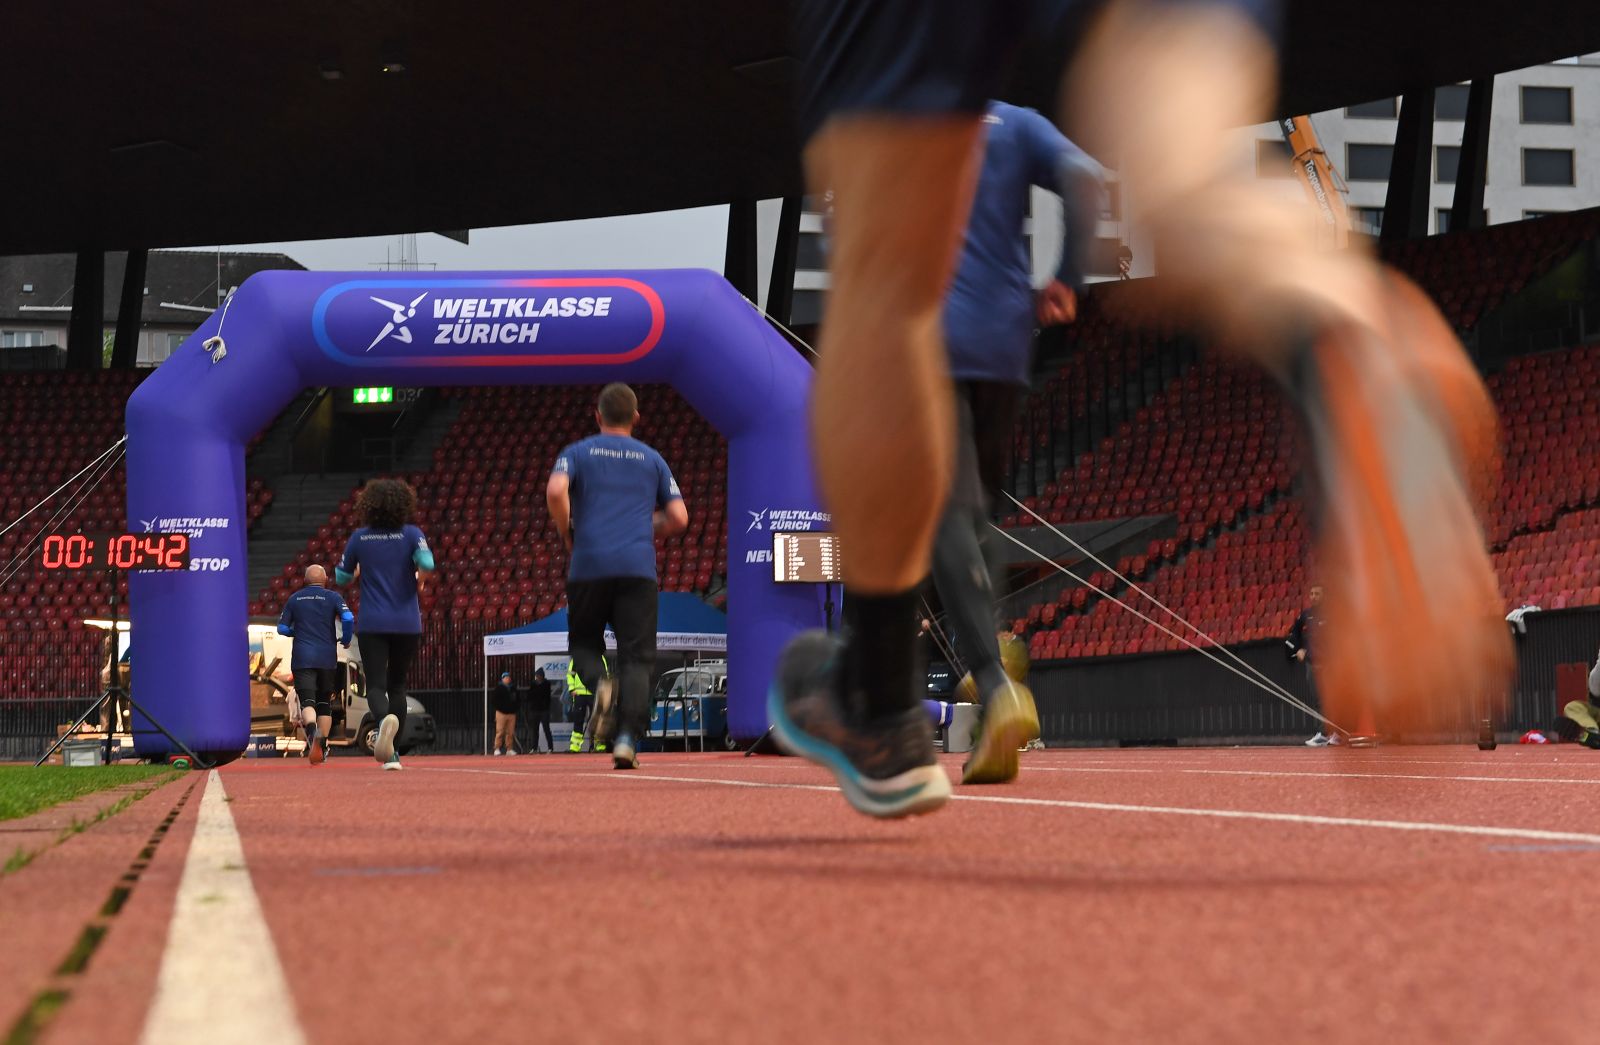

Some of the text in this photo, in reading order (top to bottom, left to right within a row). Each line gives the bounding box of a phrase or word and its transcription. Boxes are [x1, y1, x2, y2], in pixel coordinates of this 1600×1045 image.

[433, 296, 612, 319] WELTKLASSE
[433, 319, 540, 344] ZÜRICH
[769, 510, 832, 522] WELTKLASSE
[159, 517, 229, 529] WELTKLASSE
[769, 516, 812, 530] ZÜRICH
[189, 557, 230, 571] STOP
[488, 637, 504, 646] ZKS
[545, 662, 568, 671] ZKS
